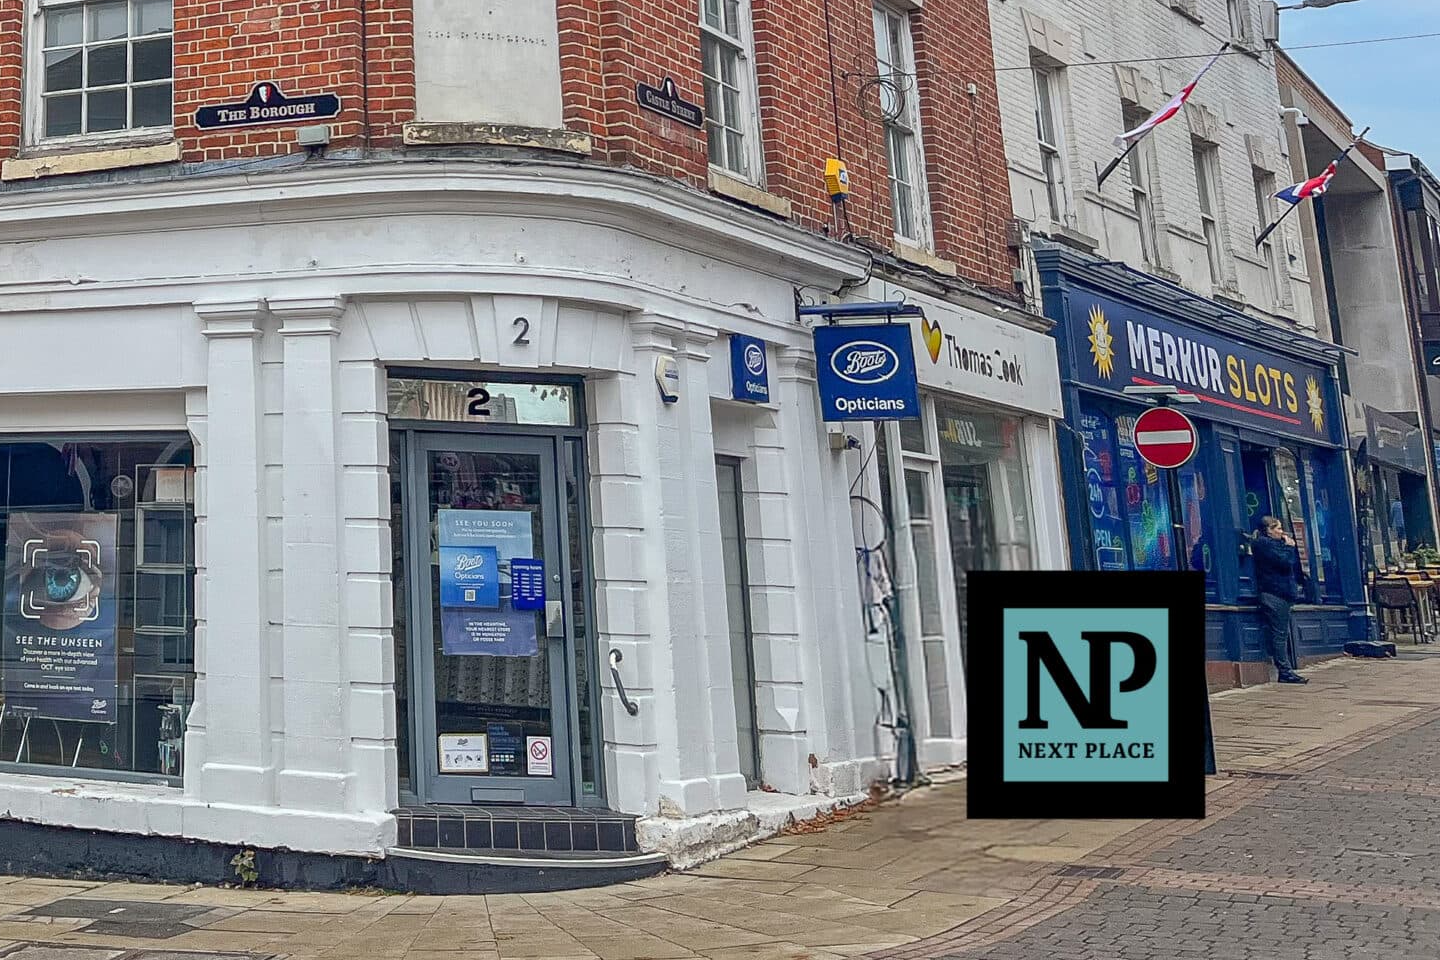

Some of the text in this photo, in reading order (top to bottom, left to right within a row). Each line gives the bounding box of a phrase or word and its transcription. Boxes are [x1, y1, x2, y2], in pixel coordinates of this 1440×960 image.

[217, 103, 316, 122] THE BOROUGH
[646, 90, 696, 121] CASTLE STREET
[512, 316, 530, 345] 2
[843, 350, 887, 375] Boots
[944, 333, 993, 378] Thomas
[1126, 320, 1299, 414] MERKUR SLOTS
[745, 380, 768, 395] Opticians
[467, 387, 491, 416] 2
[835, 397, 905, 414] Opticians
[491, 520, 514, 528] SOON
[454, 571, 484, 581] Opticians
[15, 635, 103, 648] SEE THE UNSEEN
